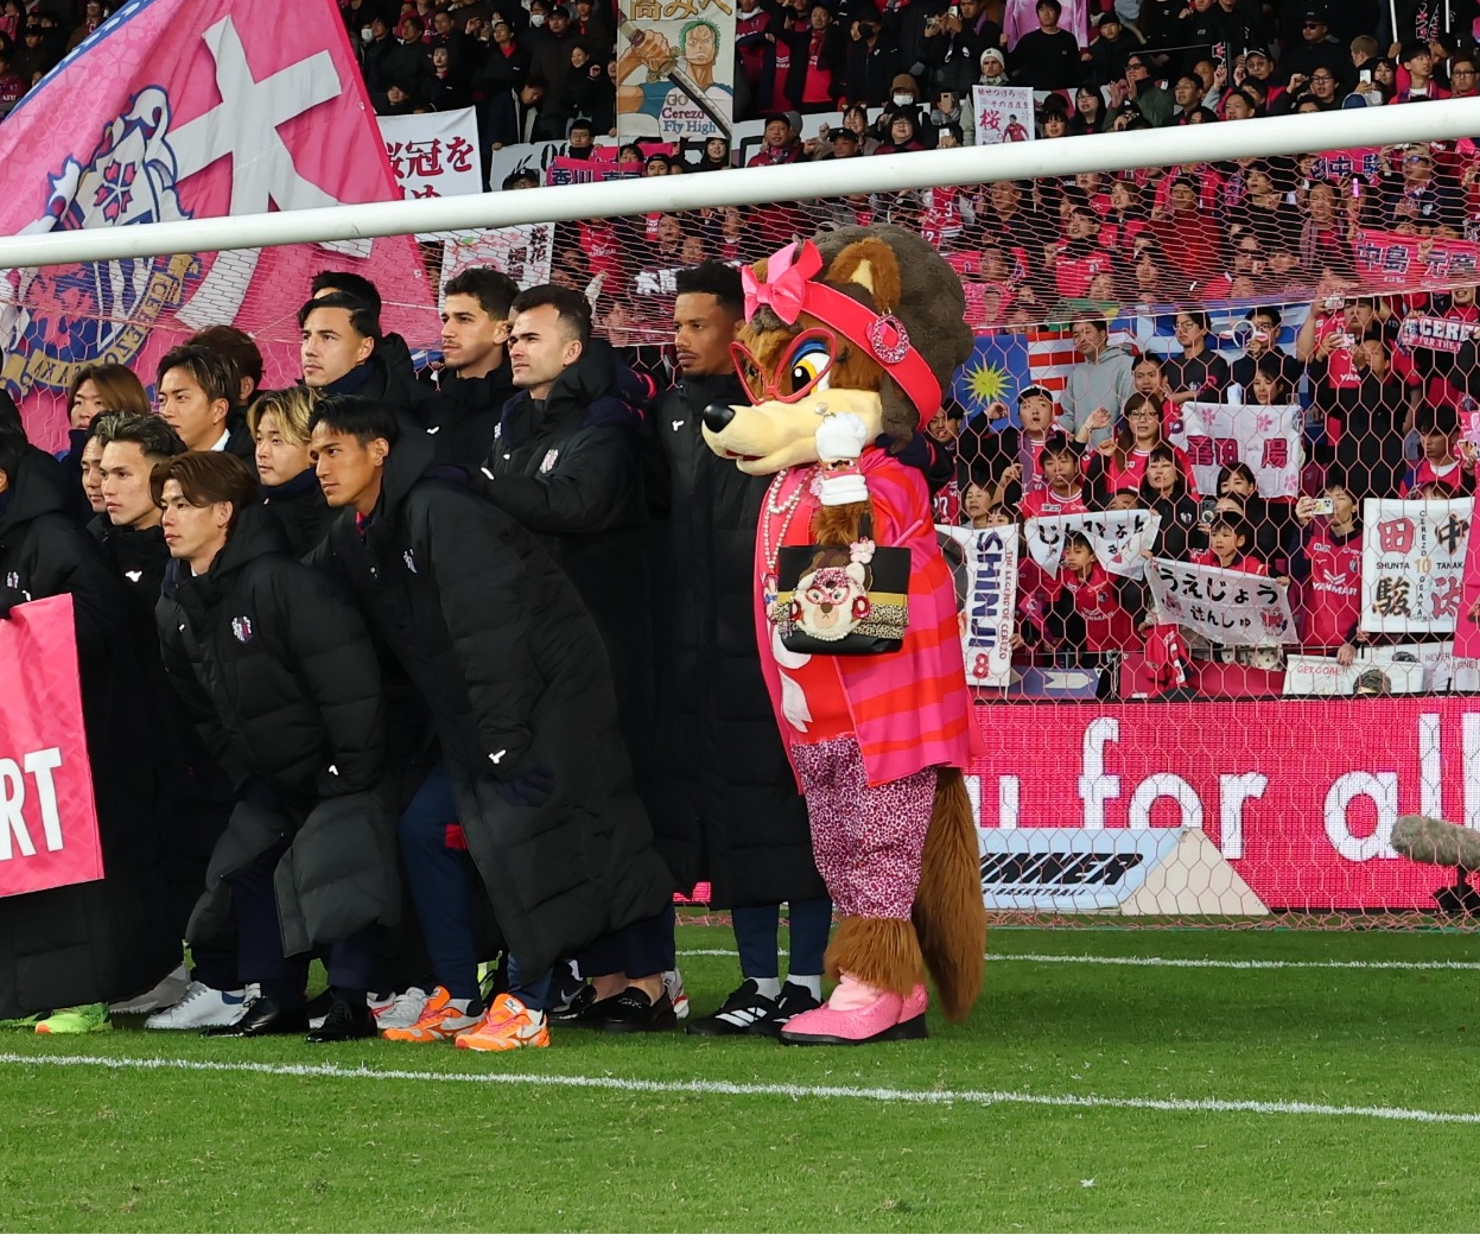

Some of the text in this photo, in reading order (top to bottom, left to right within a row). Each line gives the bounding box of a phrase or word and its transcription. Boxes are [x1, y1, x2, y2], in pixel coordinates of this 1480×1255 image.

[666, 93, 689, 108] GO
[662, 107, 706, 122] Cerezo
[979, 108, 1002, 133] 桜
[663, 119, 717, 136] Fly High
[1376, 561, 1411, 571] SHUNTA
[1436, 561, 1464, 571] TANAK
[968, 530, 1004, 648] SHINJI
[1157, 566, 1280, 606] うえじょう
[1312, 581, 1358, 596] YANMAR
[972, 652, 990, 680] 8
[1078, 715, 1268, 860] for
